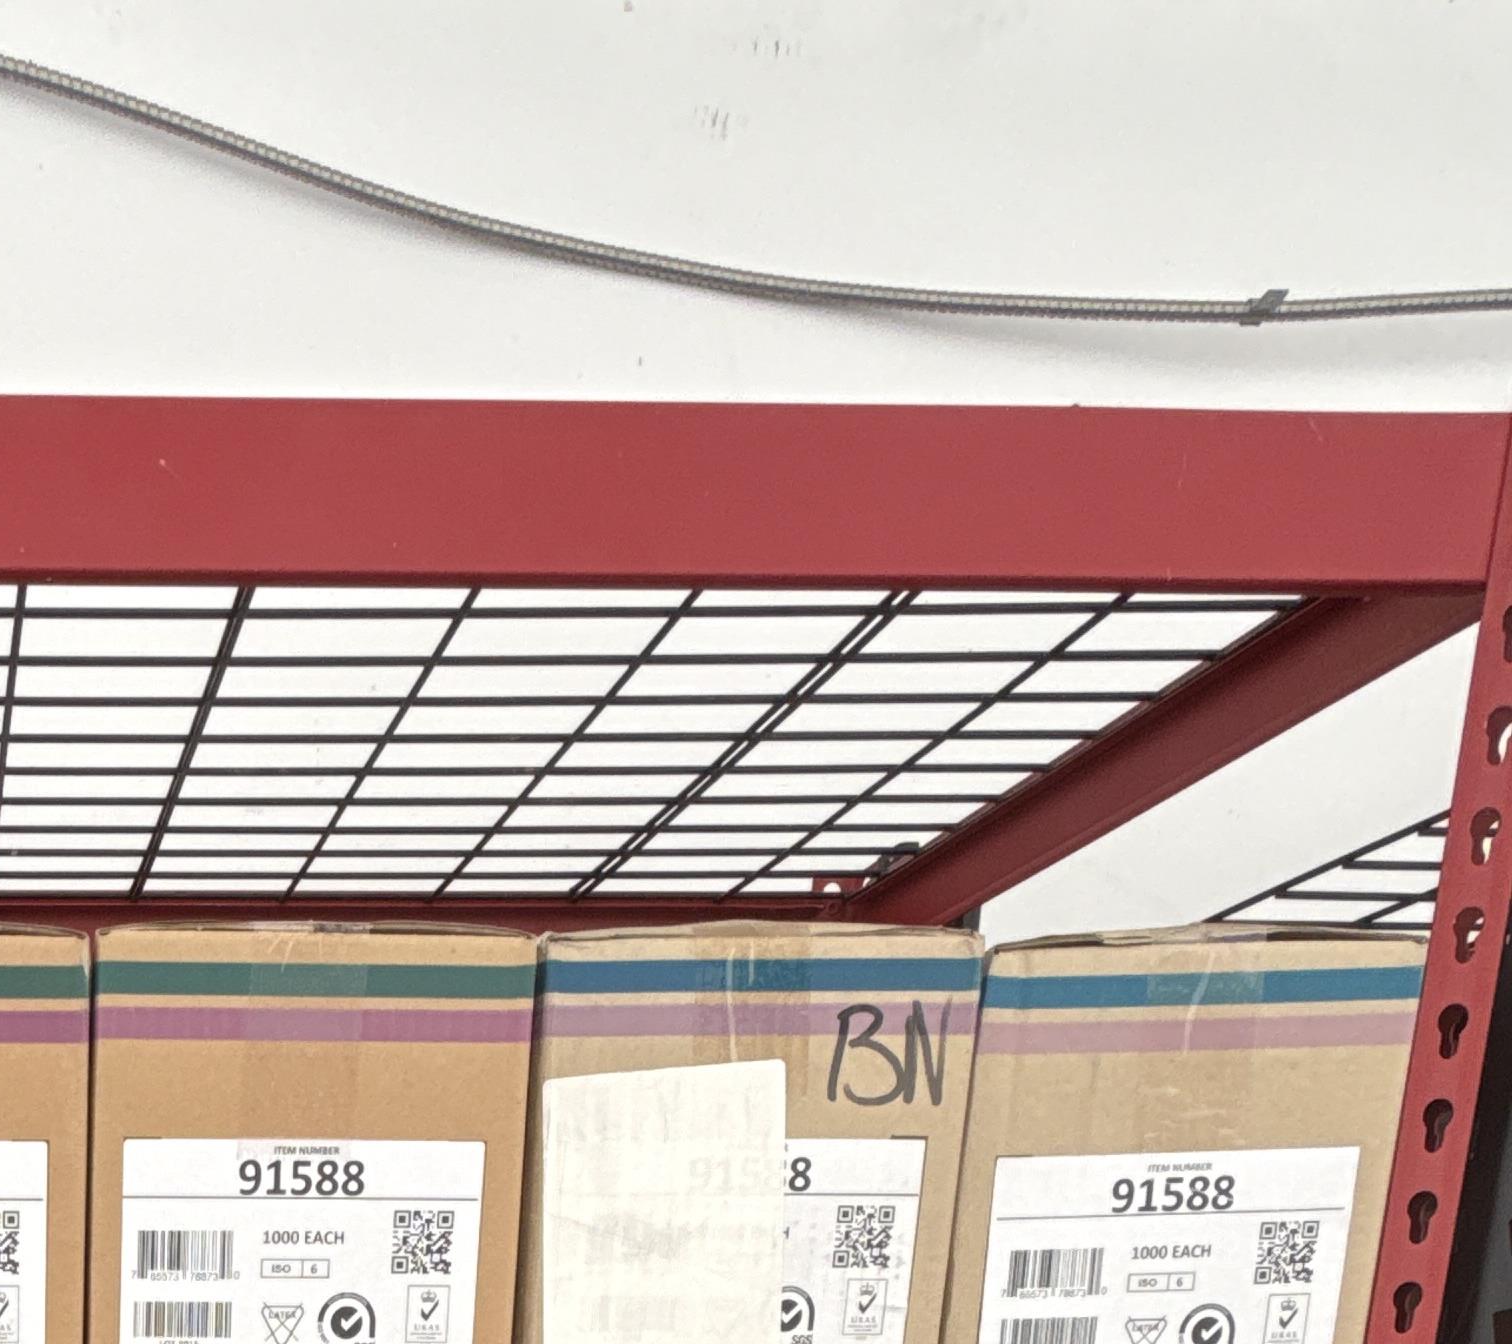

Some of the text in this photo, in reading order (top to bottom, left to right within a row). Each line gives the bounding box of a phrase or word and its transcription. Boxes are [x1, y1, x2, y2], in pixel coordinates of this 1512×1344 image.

[238, 1160, 366, 1196] 91588
[1110, 1175, 1237, 1214] 91588
[263, 1231, 345, 1245] 1000 EACH
[1131, 1244, 1211, 1260] 1000 EACH
[272, 1264, 317, 1275] ISO 6
[1137, 1278, 1156, 1288] ISO
